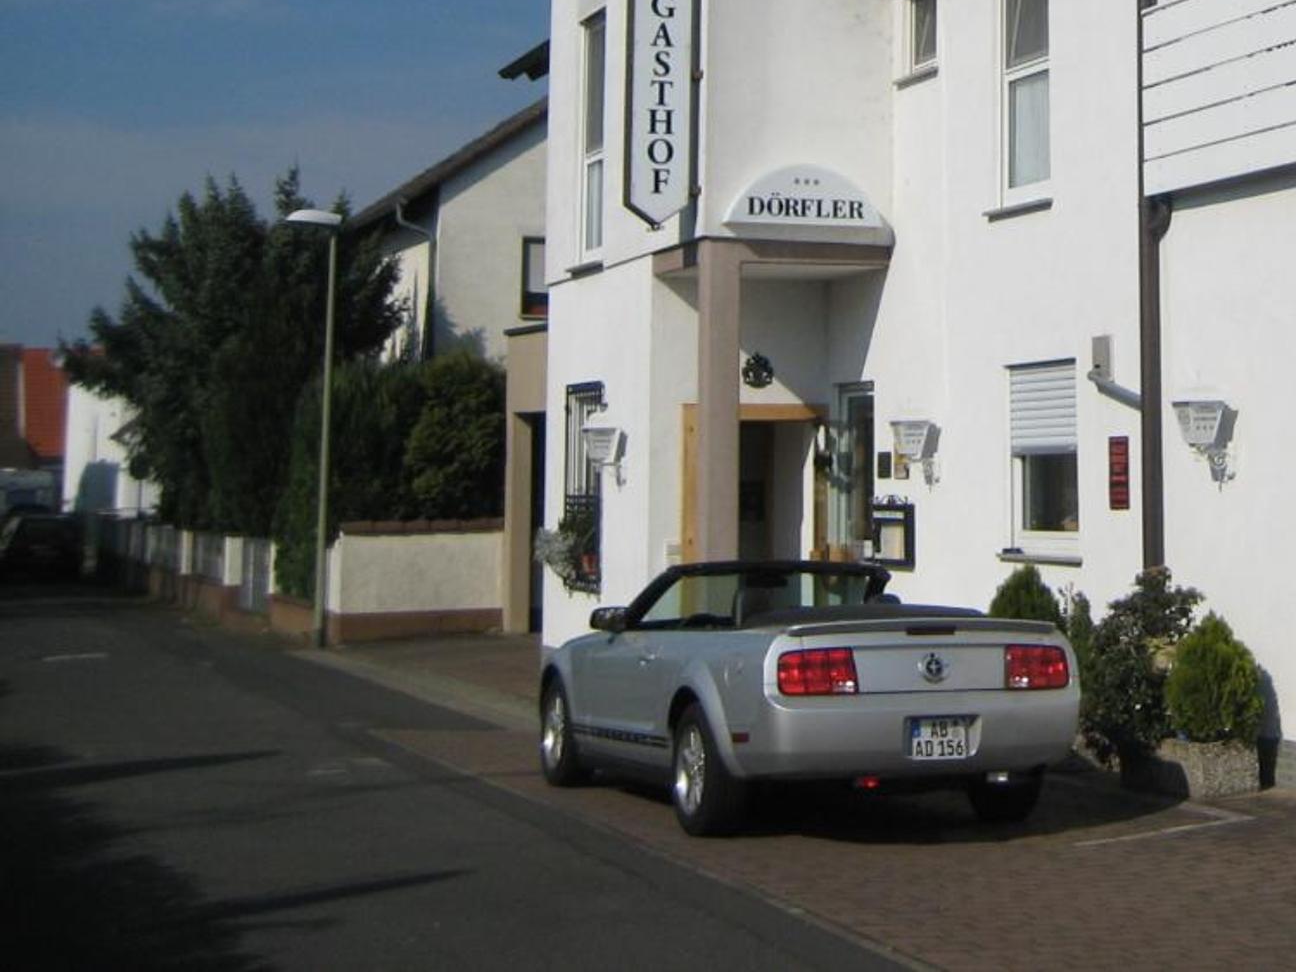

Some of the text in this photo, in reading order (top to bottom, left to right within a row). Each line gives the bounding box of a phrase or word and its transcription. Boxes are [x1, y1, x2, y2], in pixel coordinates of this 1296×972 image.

[747, 191, 865, 220] DÖRFLER
[930, 721, 948, 738] AB
[915, 739, 963, 757] AD 156
